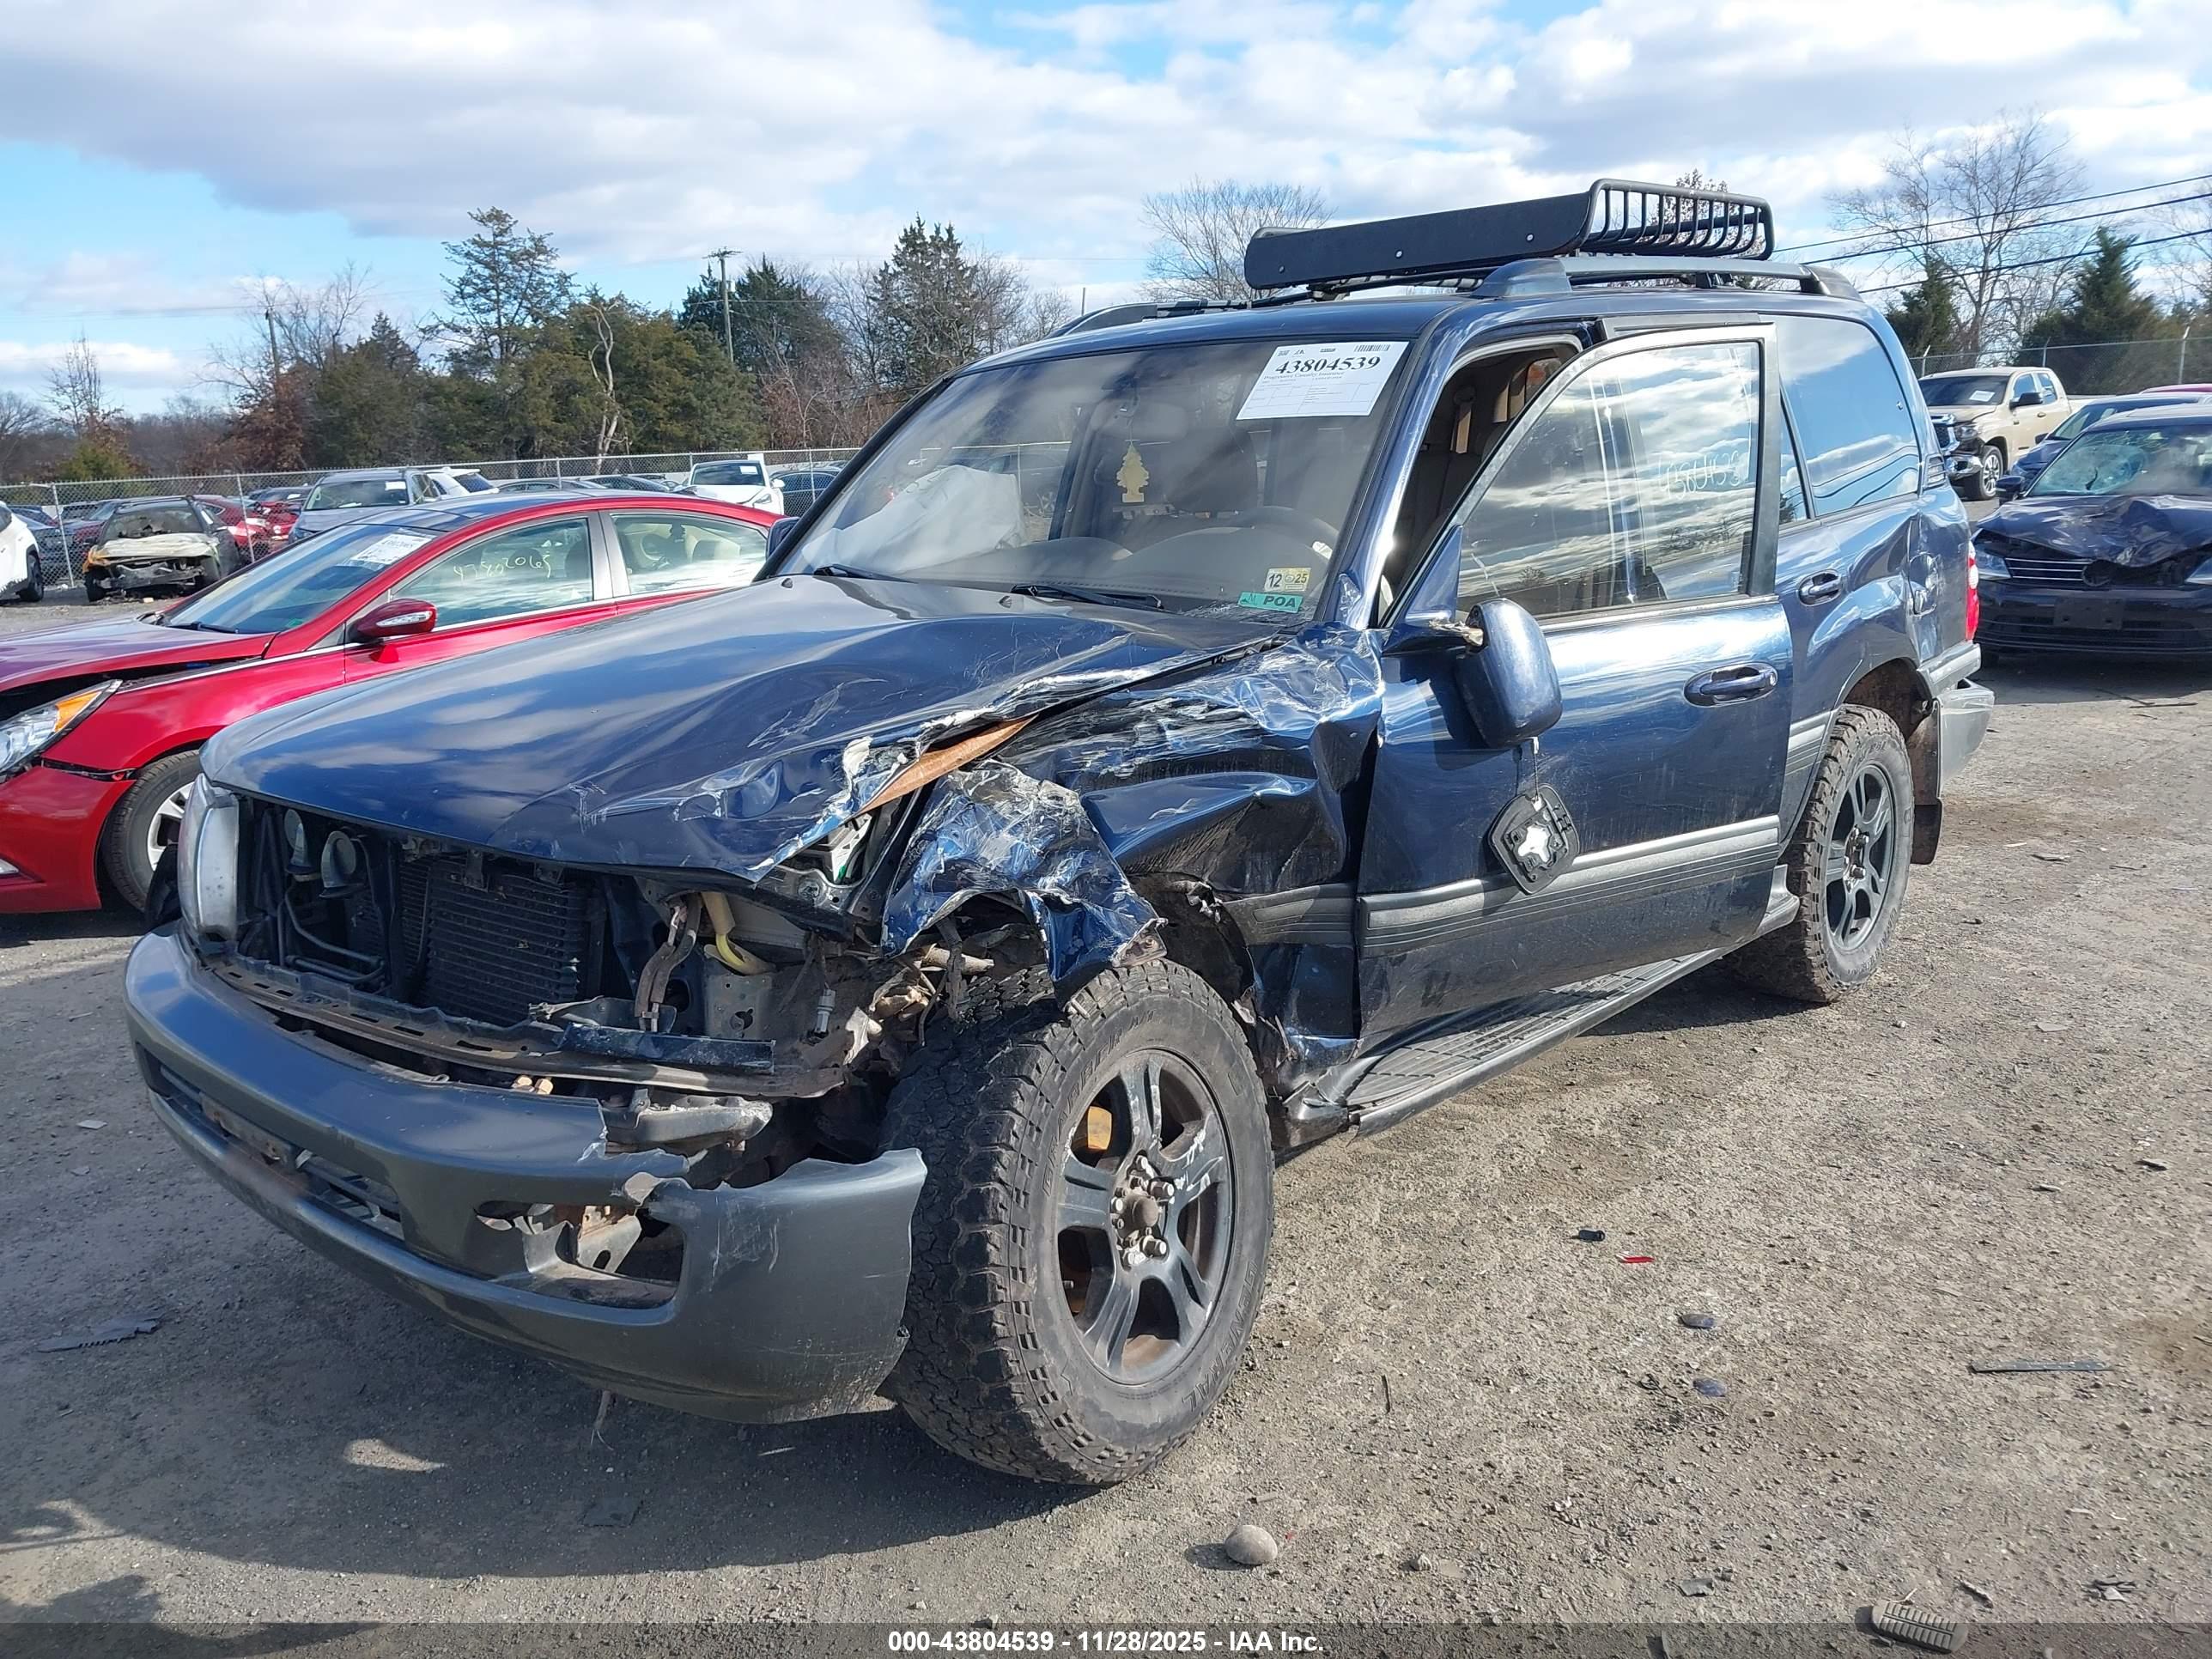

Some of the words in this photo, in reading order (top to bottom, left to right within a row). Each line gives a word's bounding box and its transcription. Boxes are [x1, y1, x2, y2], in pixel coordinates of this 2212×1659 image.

[1275, 356, 1381, 374] 43804539
[1268, 574, 1282, 587] 12
[1294, 573, 1308, 583] 25
[1263, 595, 1296, 608] POA
[1182, 1261, 1258, 1413] GENERAL
